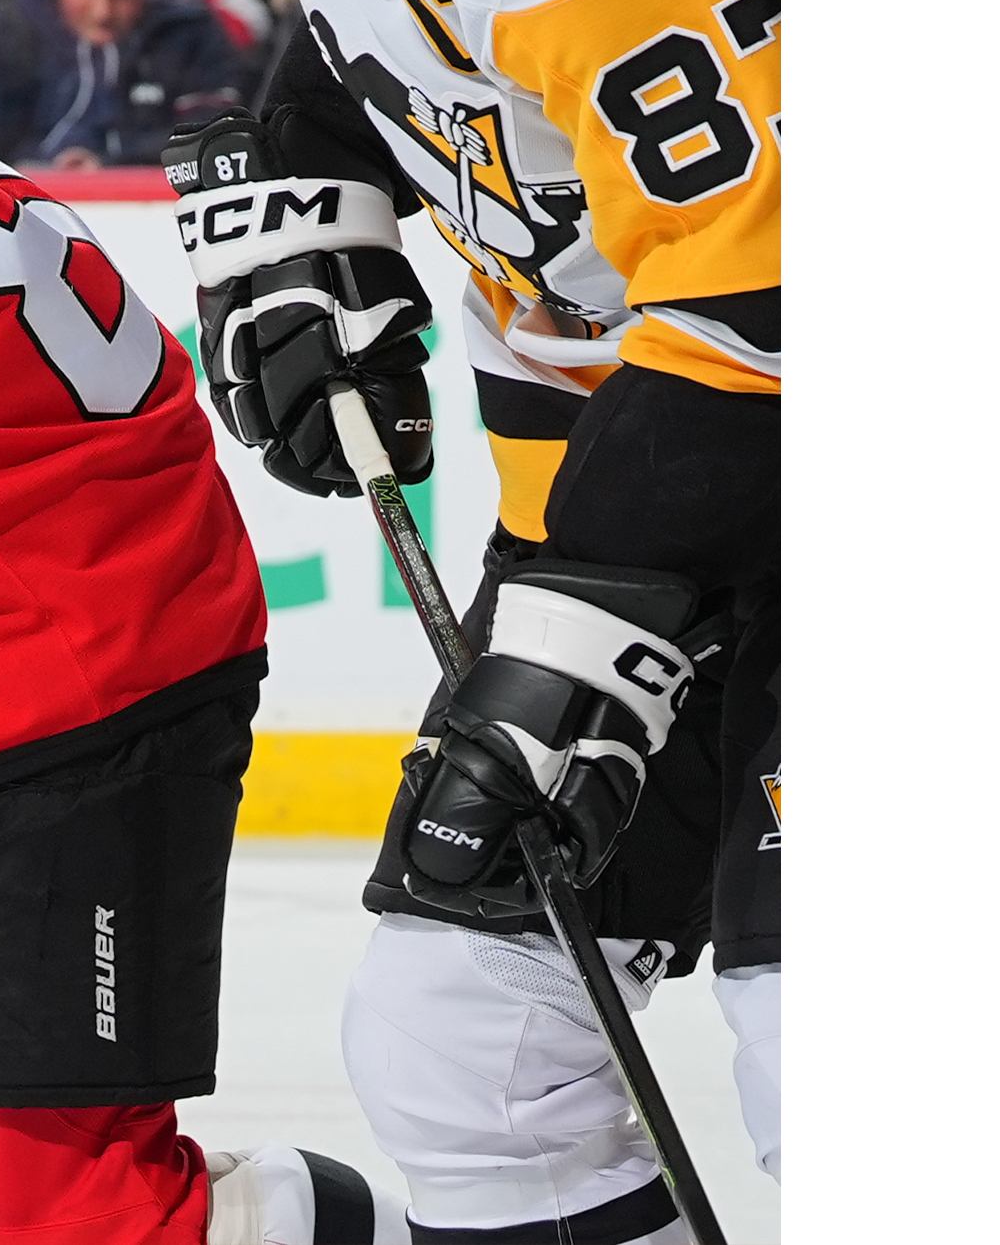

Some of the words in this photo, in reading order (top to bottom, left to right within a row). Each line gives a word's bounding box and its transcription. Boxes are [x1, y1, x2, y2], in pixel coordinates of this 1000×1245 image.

[213, 151, 249, 182] 87
[176, 184, 343, 253] CCM
[417, 818, 484, 851] CCM
